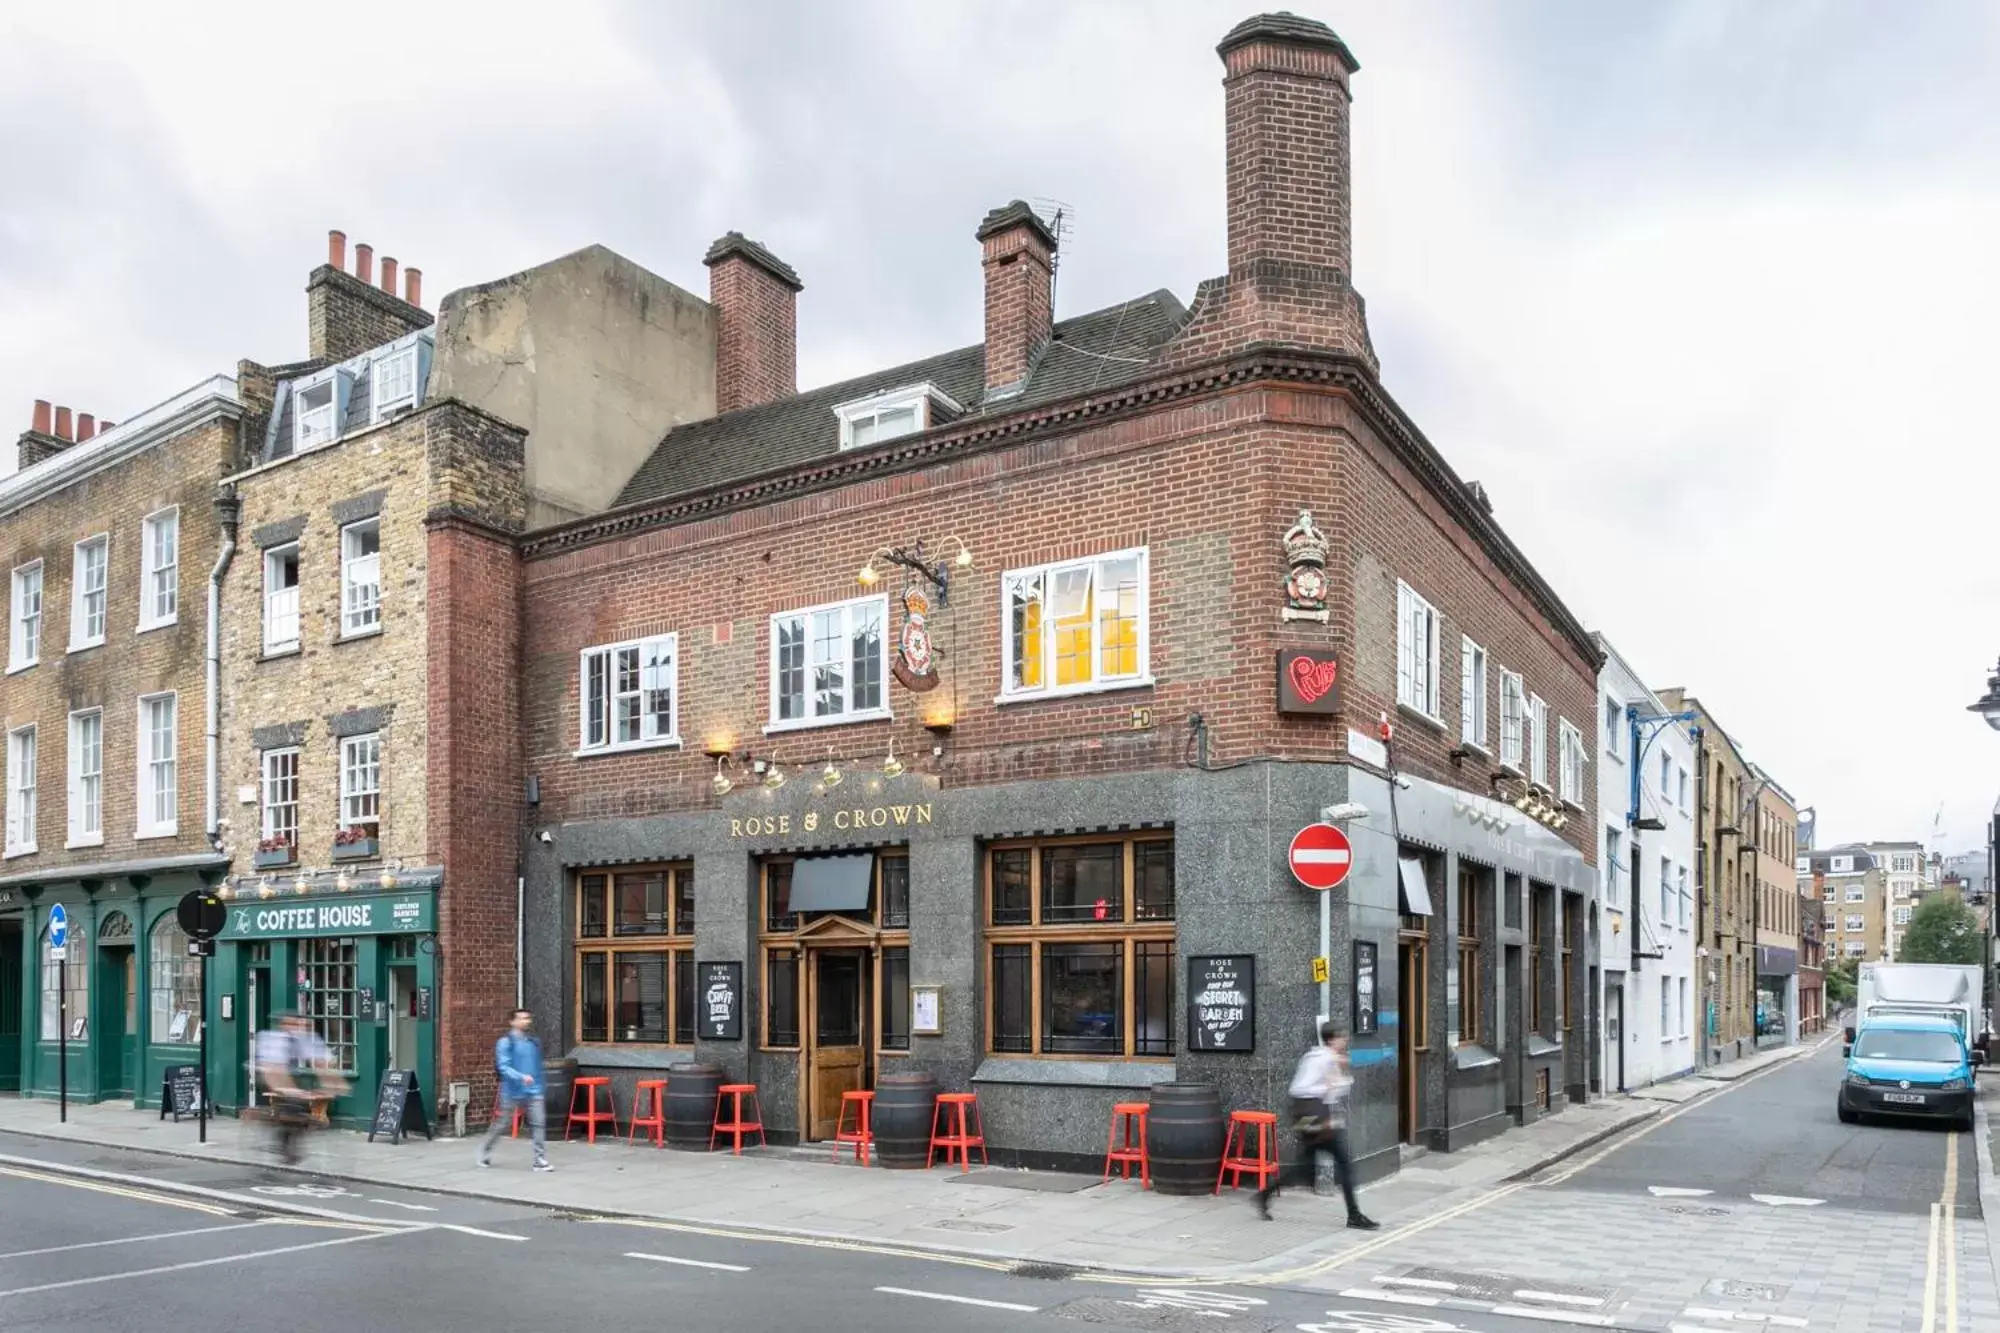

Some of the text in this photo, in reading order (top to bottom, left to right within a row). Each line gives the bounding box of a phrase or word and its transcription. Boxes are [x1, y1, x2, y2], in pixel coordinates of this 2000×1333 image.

[731, 804, 932, 836] ROSE & CROWN
[257, 908, 315, 930] COFFEE
[319, 904, 372, 928] HOUSE
[1315, 960, 1328, 980] H
[1203, 990, 1240, 1006] SECRET
[1199, 1007, 1243, 1021] GARDEN
